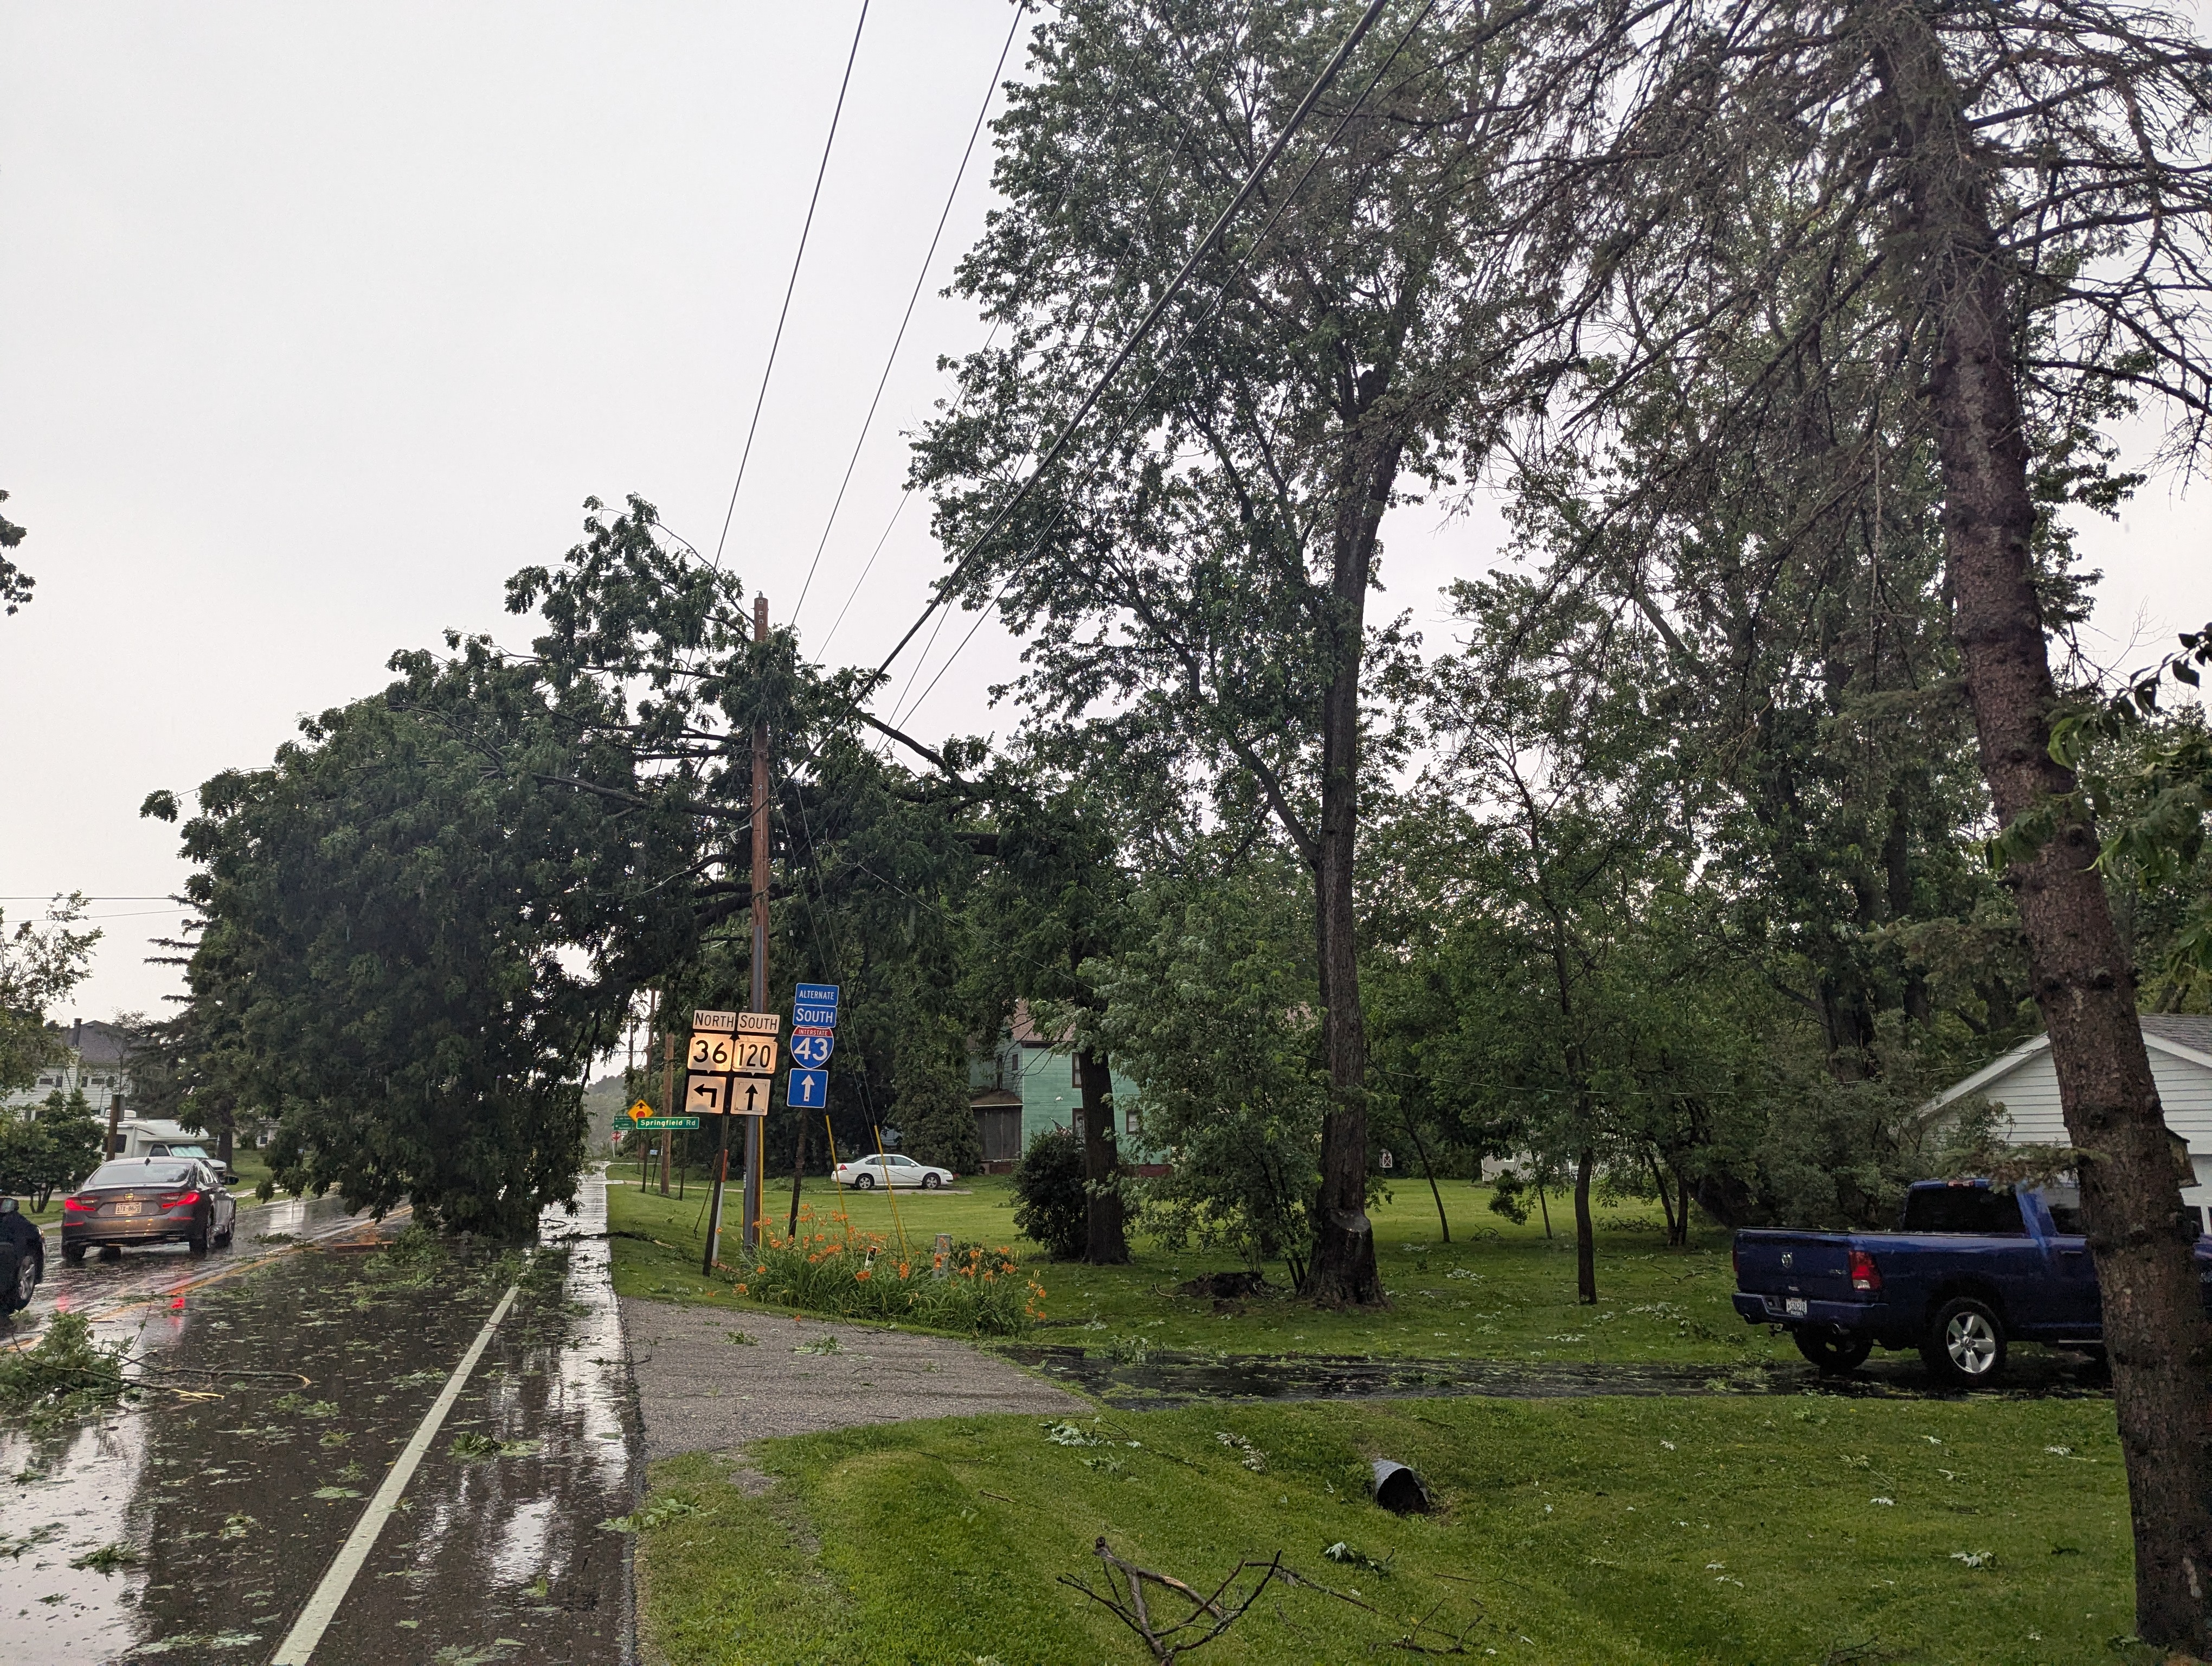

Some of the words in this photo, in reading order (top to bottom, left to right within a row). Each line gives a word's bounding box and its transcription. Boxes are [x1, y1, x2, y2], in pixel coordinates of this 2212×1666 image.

[799, 990, 834, 1000] ALTERNATE
[695, 1012, 734, 1028] NORTH
[739, 1015, 777, 1030] SOUTH
[795, 1008, 833, 1023] SOUTH
[693, 1040, 728, 1064] 36
[738, 1043, 771, 1068] 120
[794, 1037, 828, 1061] 43
[640, 1119, 683, 1127] Springfield
